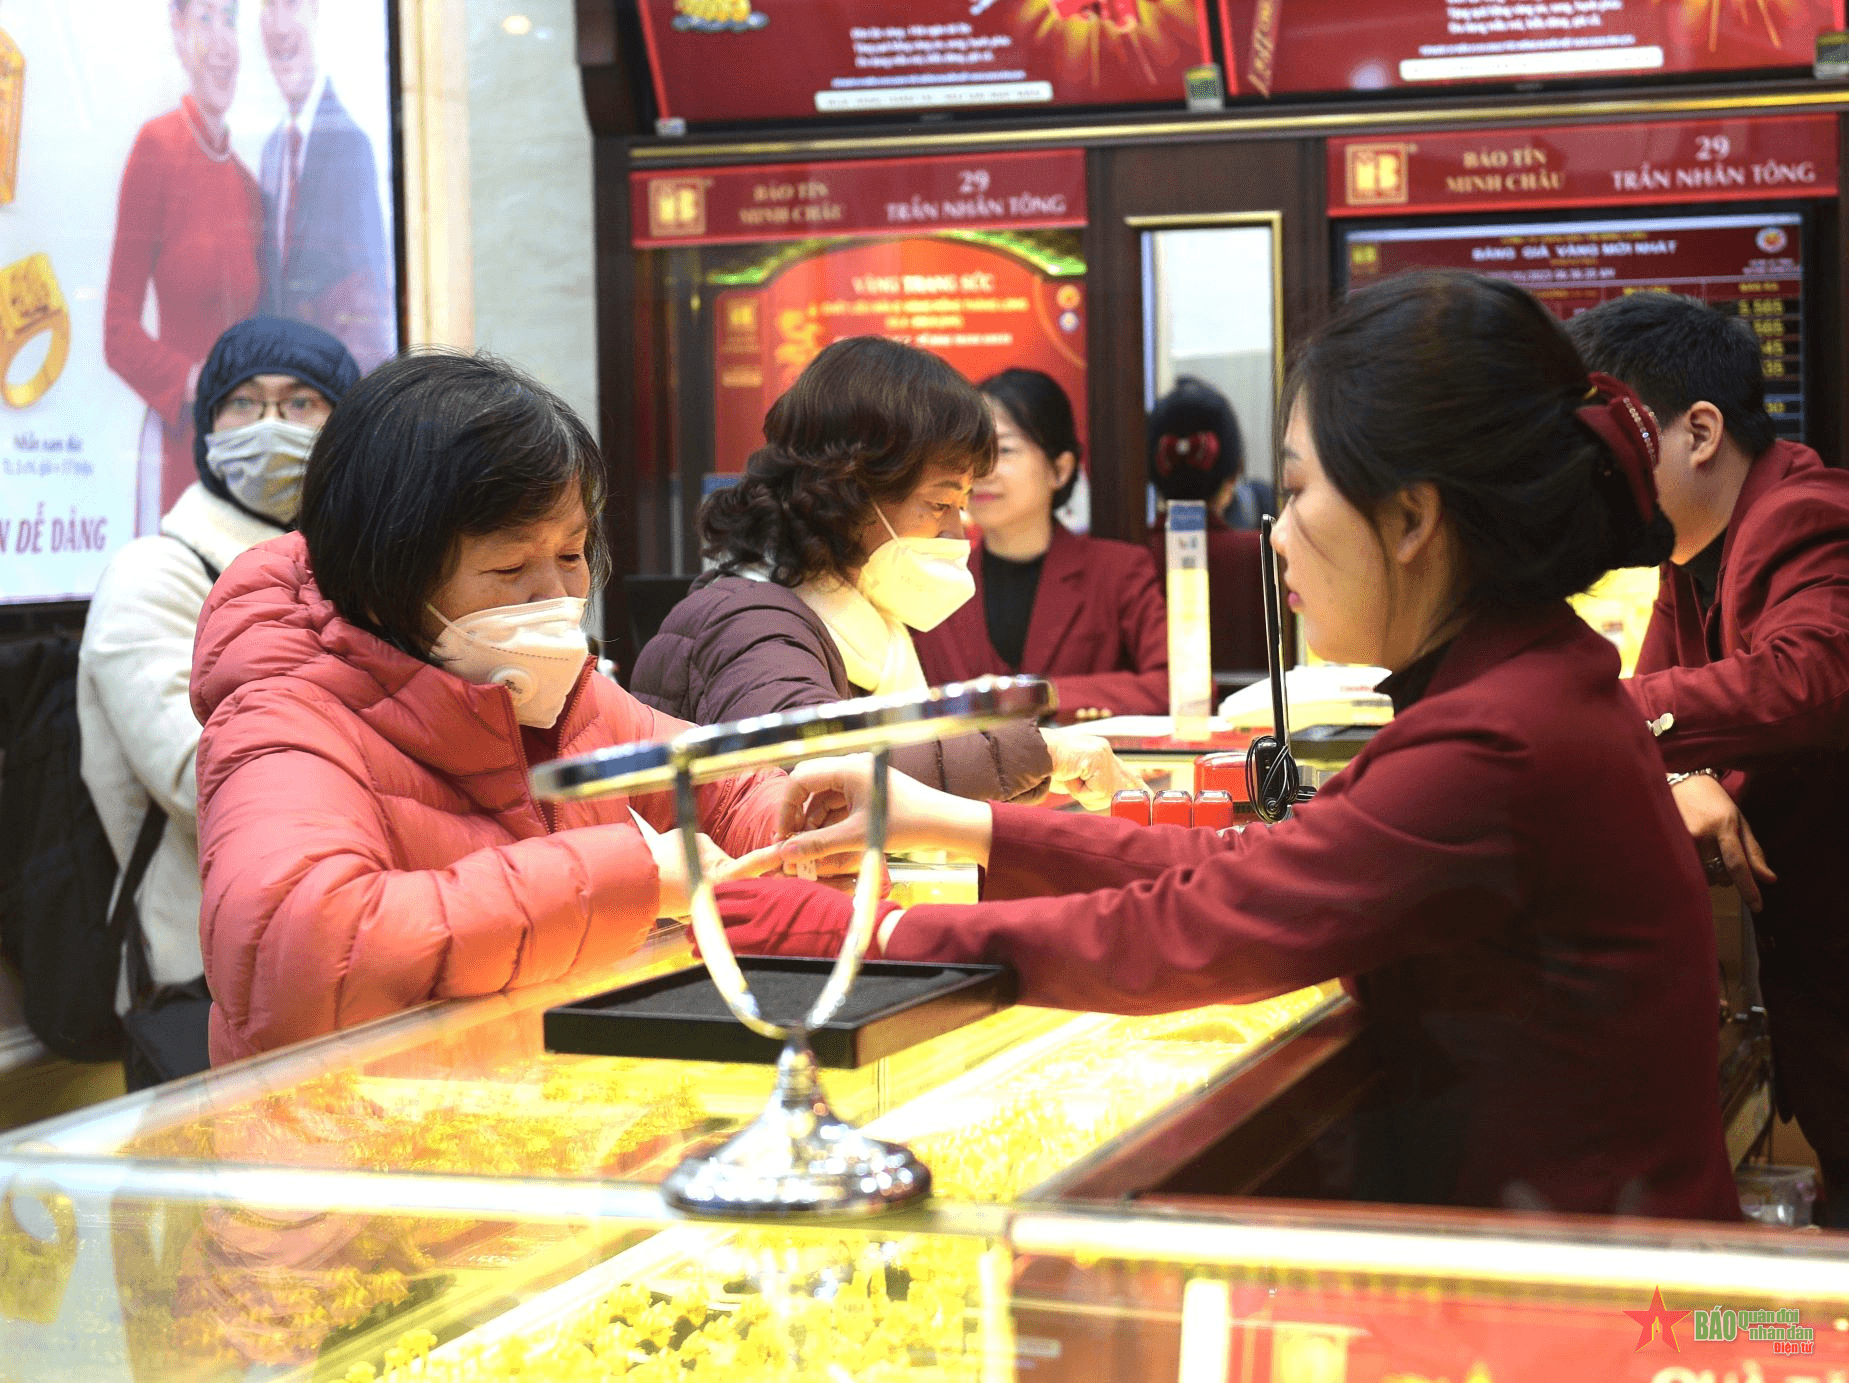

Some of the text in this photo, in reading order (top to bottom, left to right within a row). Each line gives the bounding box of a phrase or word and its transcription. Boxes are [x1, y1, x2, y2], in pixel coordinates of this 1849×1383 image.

[1463, 144, 1547, 169] BẢO TÍN
[1695, 134, 1731, 161] 29
[959, 169, 990, 194] 29
[1446, 169, 1564, 193] MINH CHÂU
[1612, 158, 1816, 191] TRẦN NHÂN TÔNG
[1009, 191, 1067, 214] TÔNG
